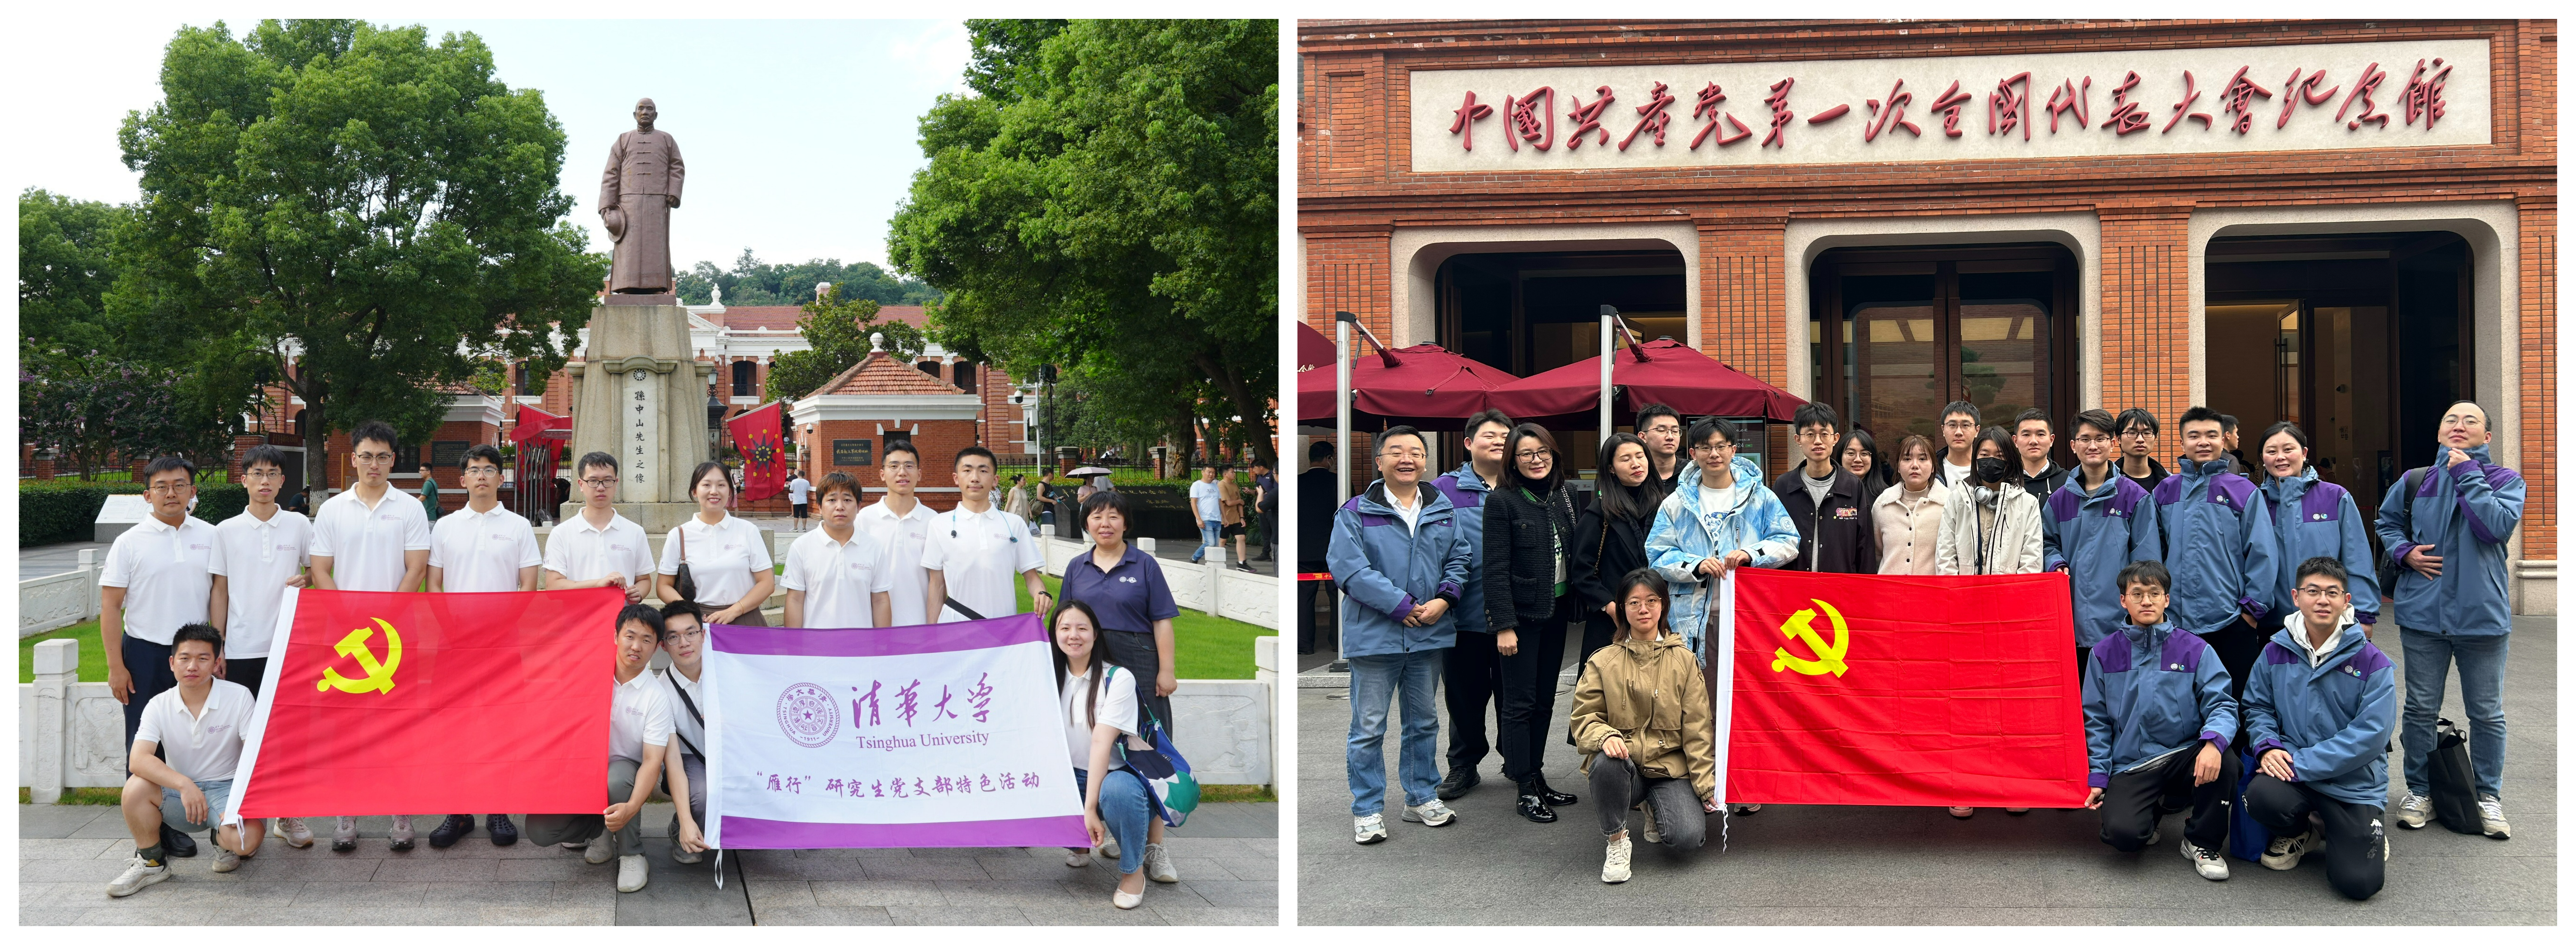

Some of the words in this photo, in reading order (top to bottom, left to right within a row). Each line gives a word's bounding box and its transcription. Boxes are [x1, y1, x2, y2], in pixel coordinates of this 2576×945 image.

[635, 390, 645, 483] 孫中山先生之像
[782, 707, 796, 735] TSINGHUA
[822, 708, 834, 737] UNIVERSITY
[856, 735, 917, 752] Tsinghua
[920, 730, 989, 747] University
